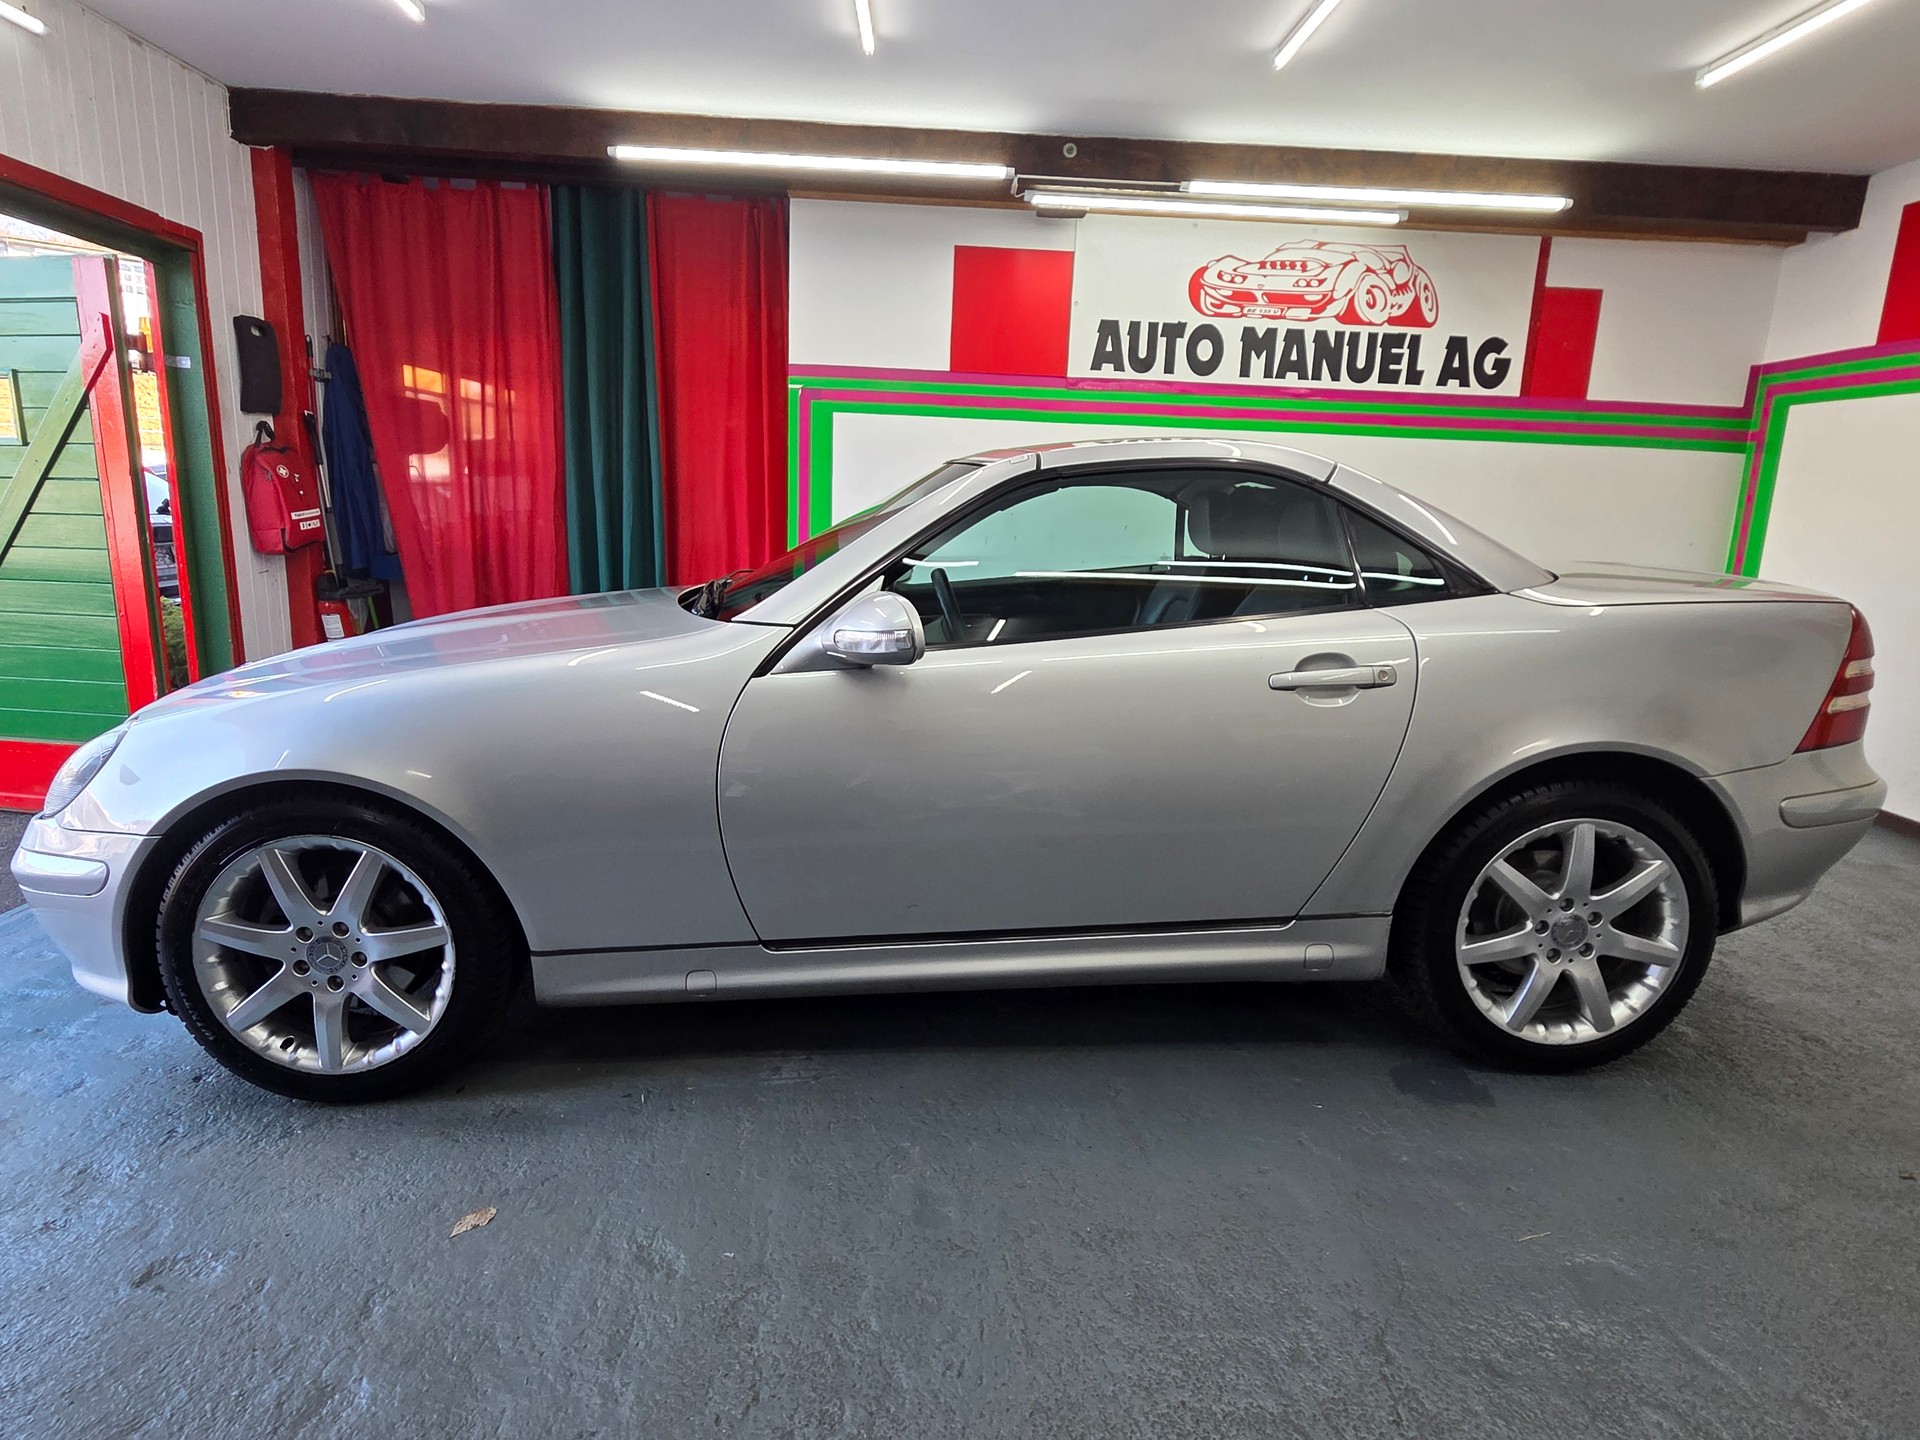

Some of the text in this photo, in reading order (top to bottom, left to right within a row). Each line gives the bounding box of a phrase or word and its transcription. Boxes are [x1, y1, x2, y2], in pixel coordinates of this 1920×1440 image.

[1090, 319, 1512, 390] AUTO MANUEL AG
